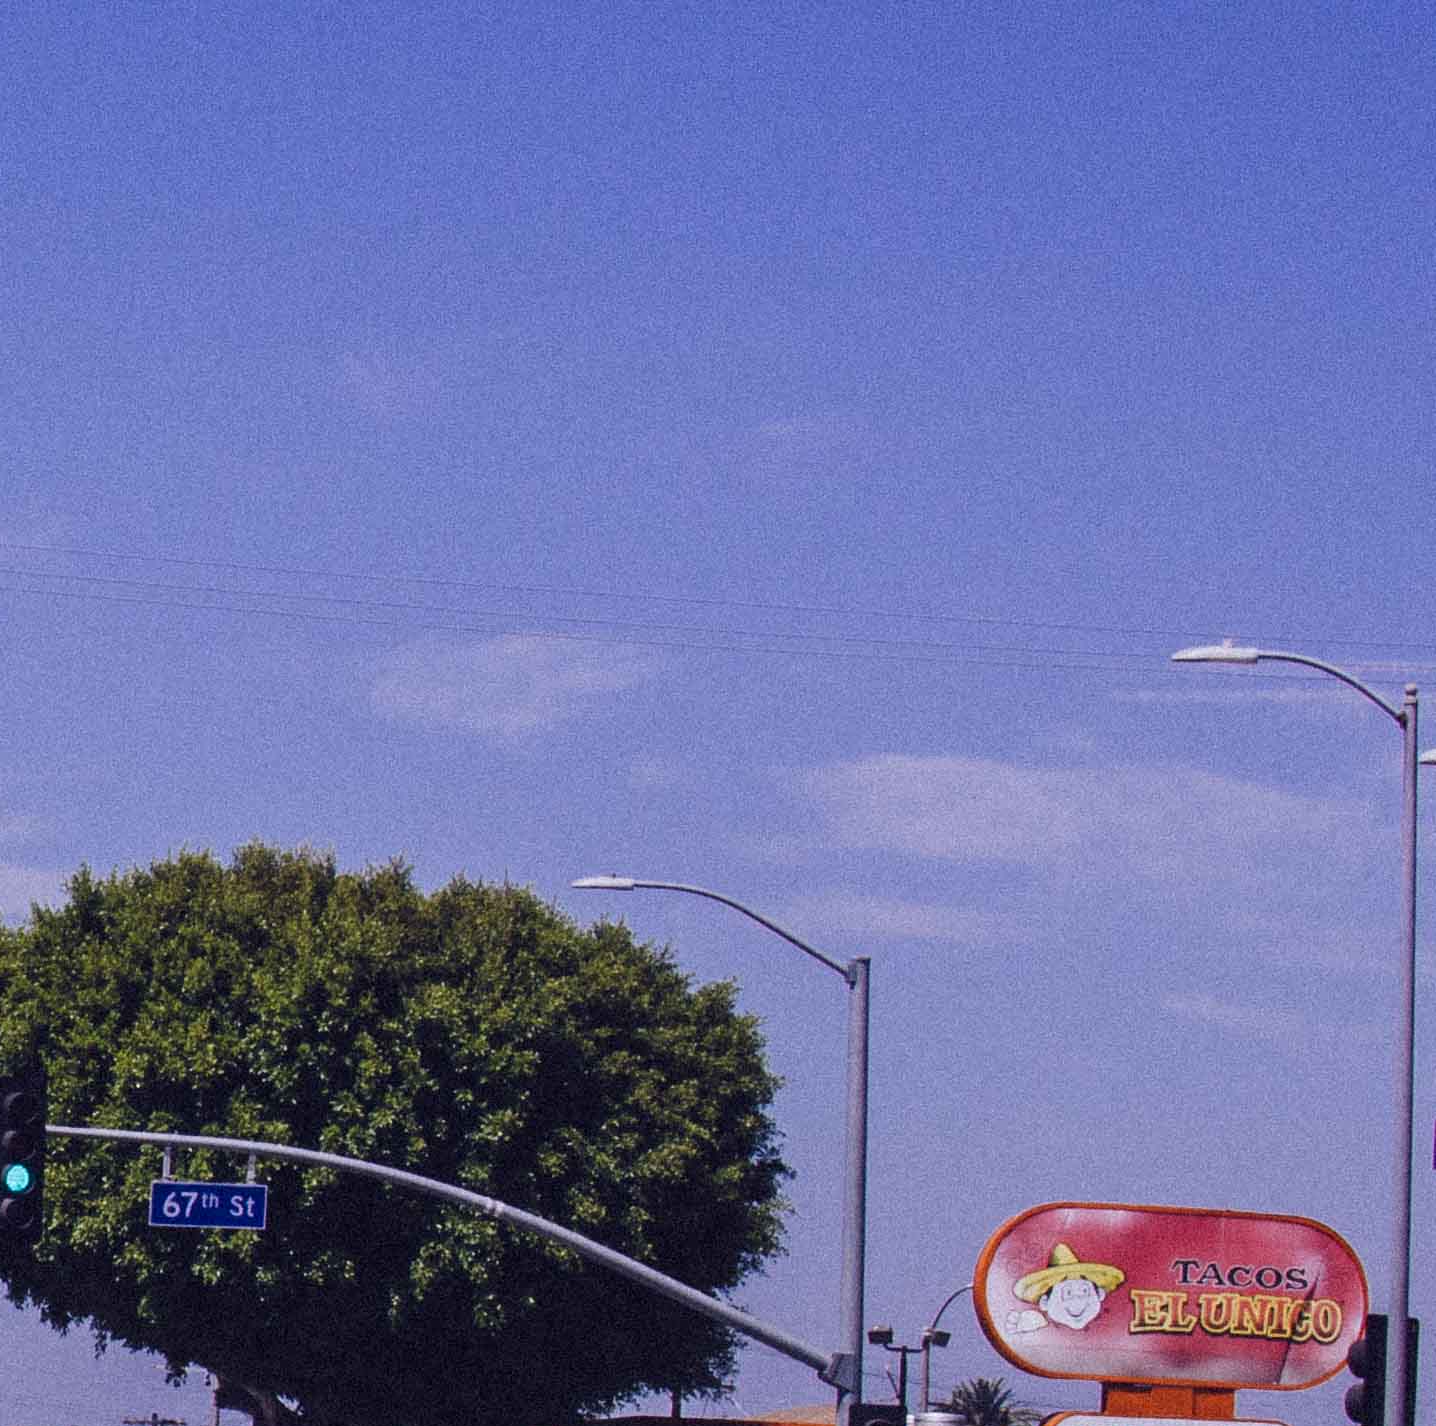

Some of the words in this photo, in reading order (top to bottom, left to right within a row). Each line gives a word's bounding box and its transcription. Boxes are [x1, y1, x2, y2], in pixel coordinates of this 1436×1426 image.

[163, 1191, 219, 1218] 67th
[230, 1195, 255, 1217] St
[1172, 1260, 1309, 1290] TACOS
[1129, 1289, 1197, 1334] EL
